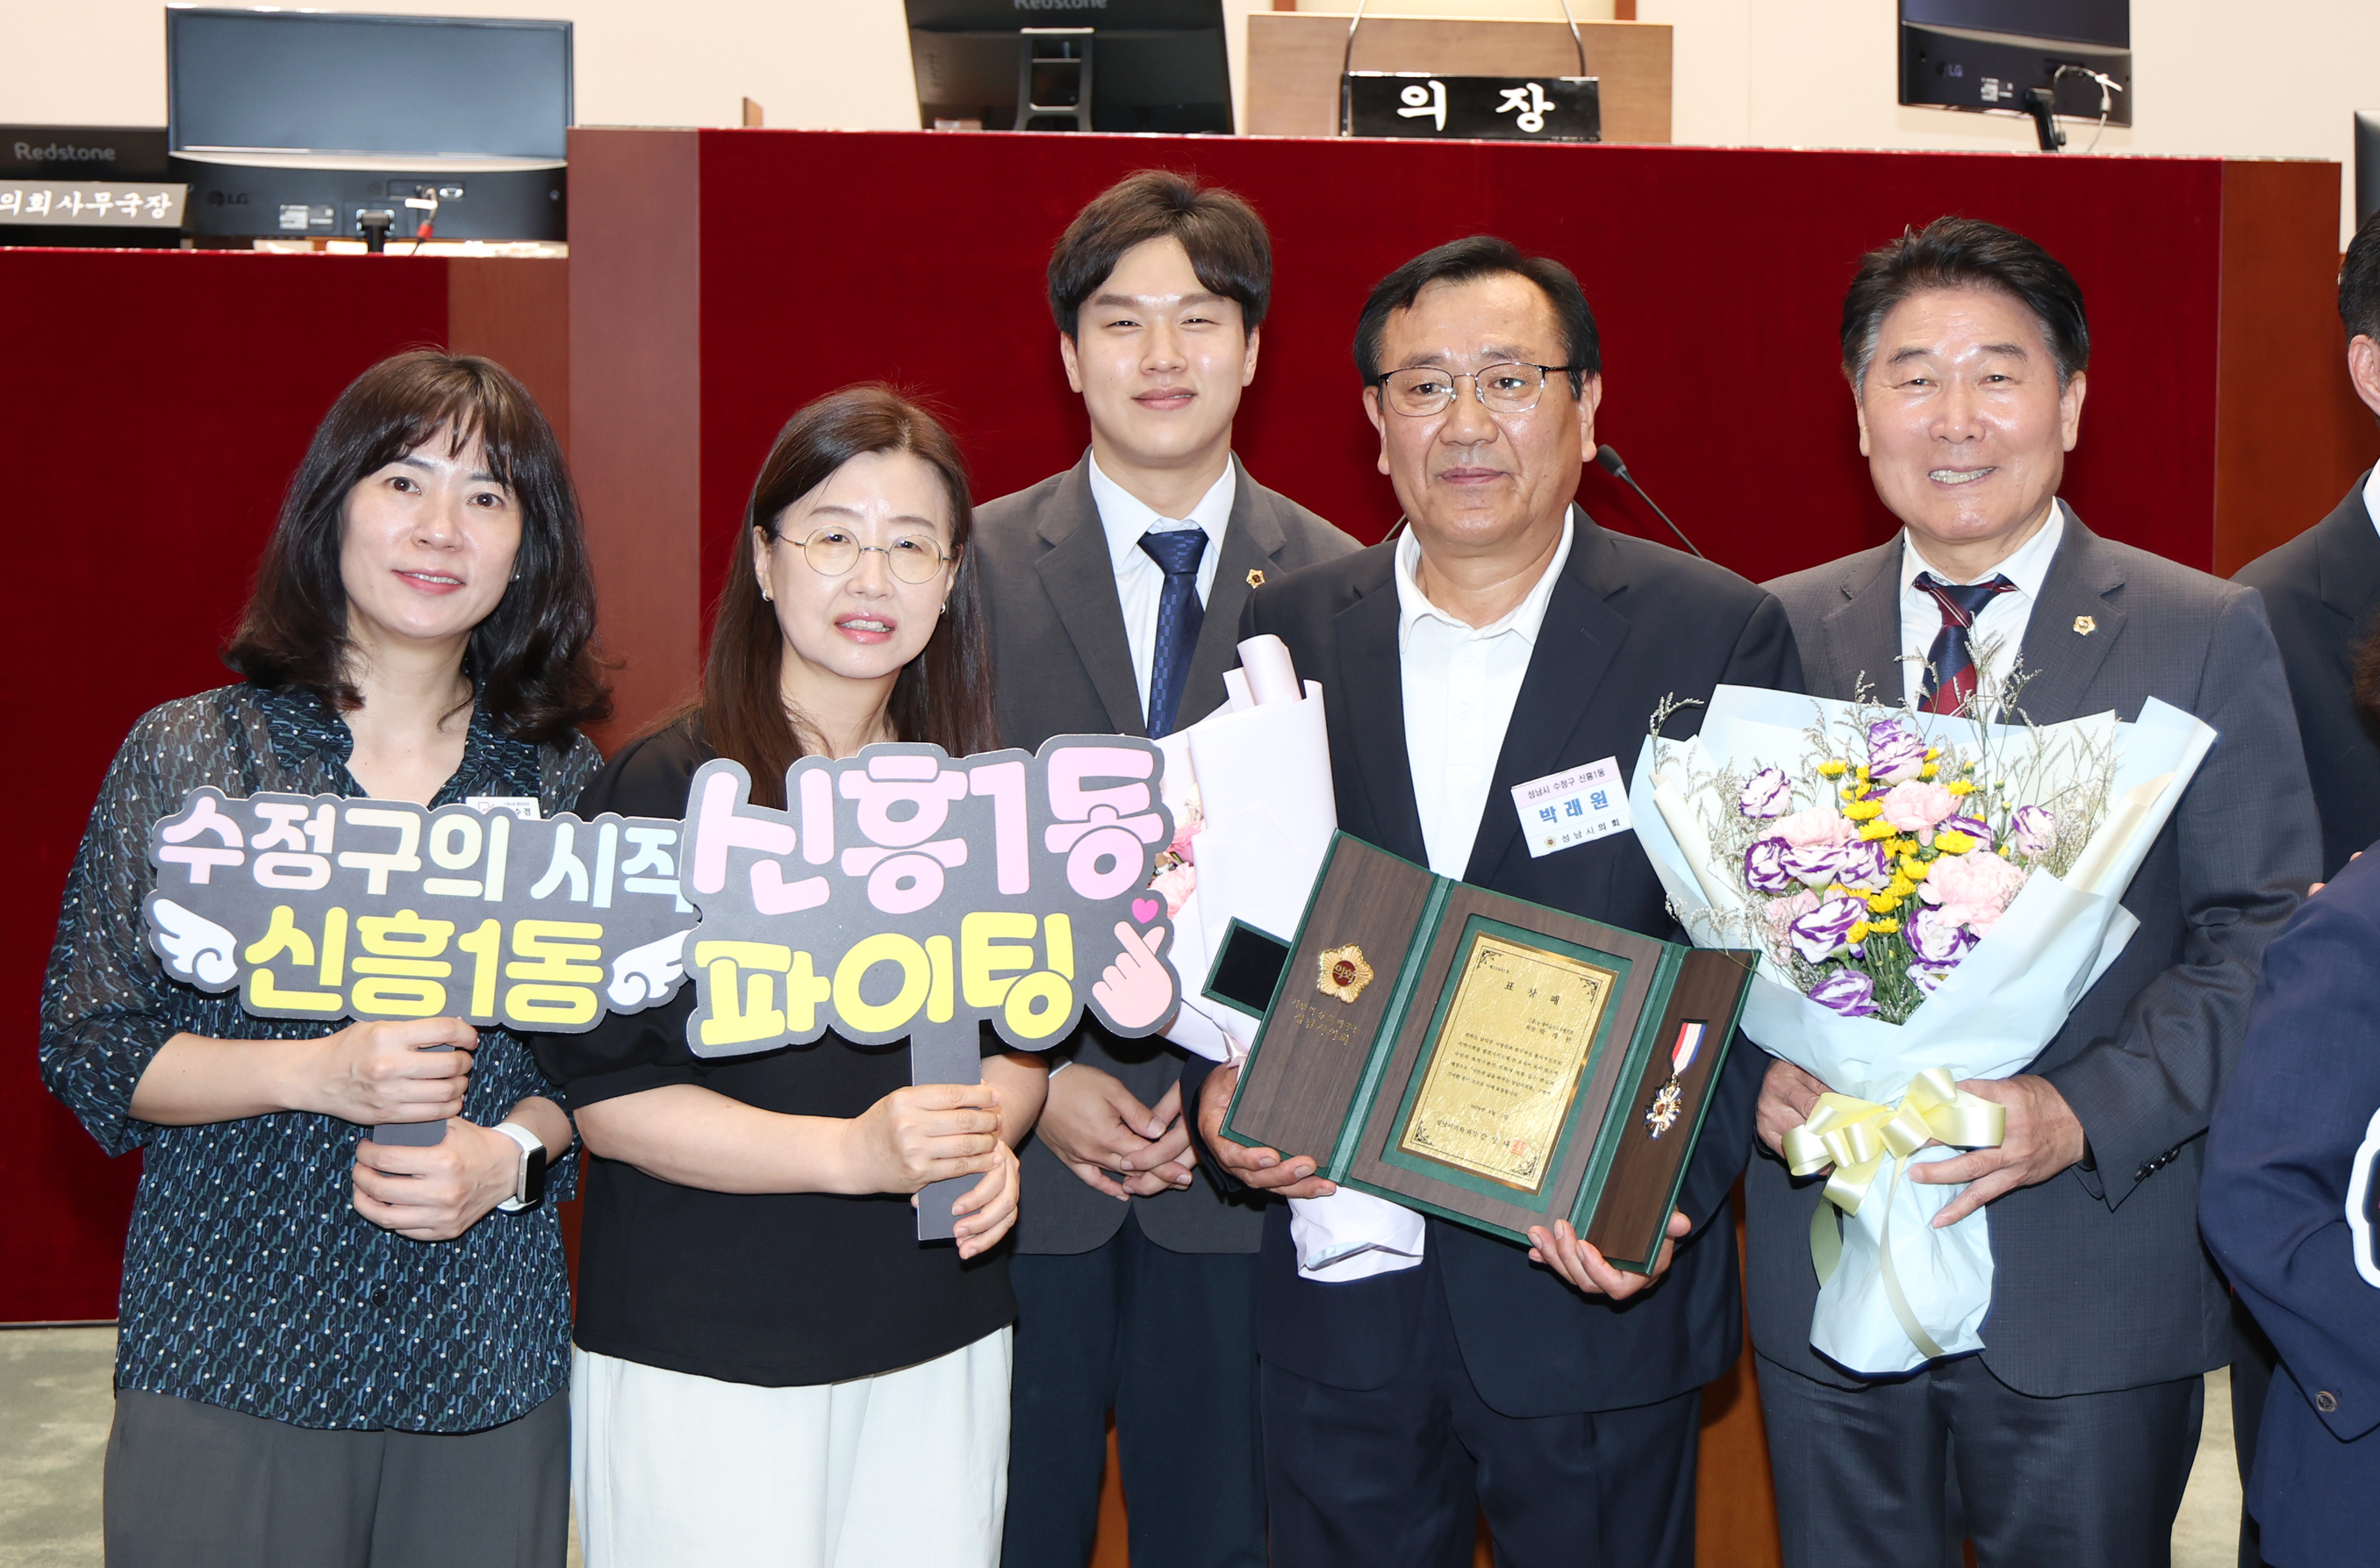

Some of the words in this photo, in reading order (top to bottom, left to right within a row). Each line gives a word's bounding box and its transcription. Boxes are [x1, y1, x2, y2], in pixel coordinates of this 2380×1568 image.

[1948, 64, 1963, 77] LG
[14, 141, 116, 161] Redstone
[0, 190, 173, 219] 의회사무국장
[227, 192, 248, 204] LG
[1528, 786, 1550, 798] 성남시
[1553, 777, 1575, 791] 수정구
[1578, 769, 1605, 784] 신흥1동
[1539, 790, 1609, 824] 박래원
[693, 747, 1164, 915] 신흥1동
[1562, 818, 1620, 843] 성남시의회
[159, 796, 511, 902] 수정구의
[244, 905, 605, 1026] 신흥1동
[694, 912, 1074, 1045] 파이팅
